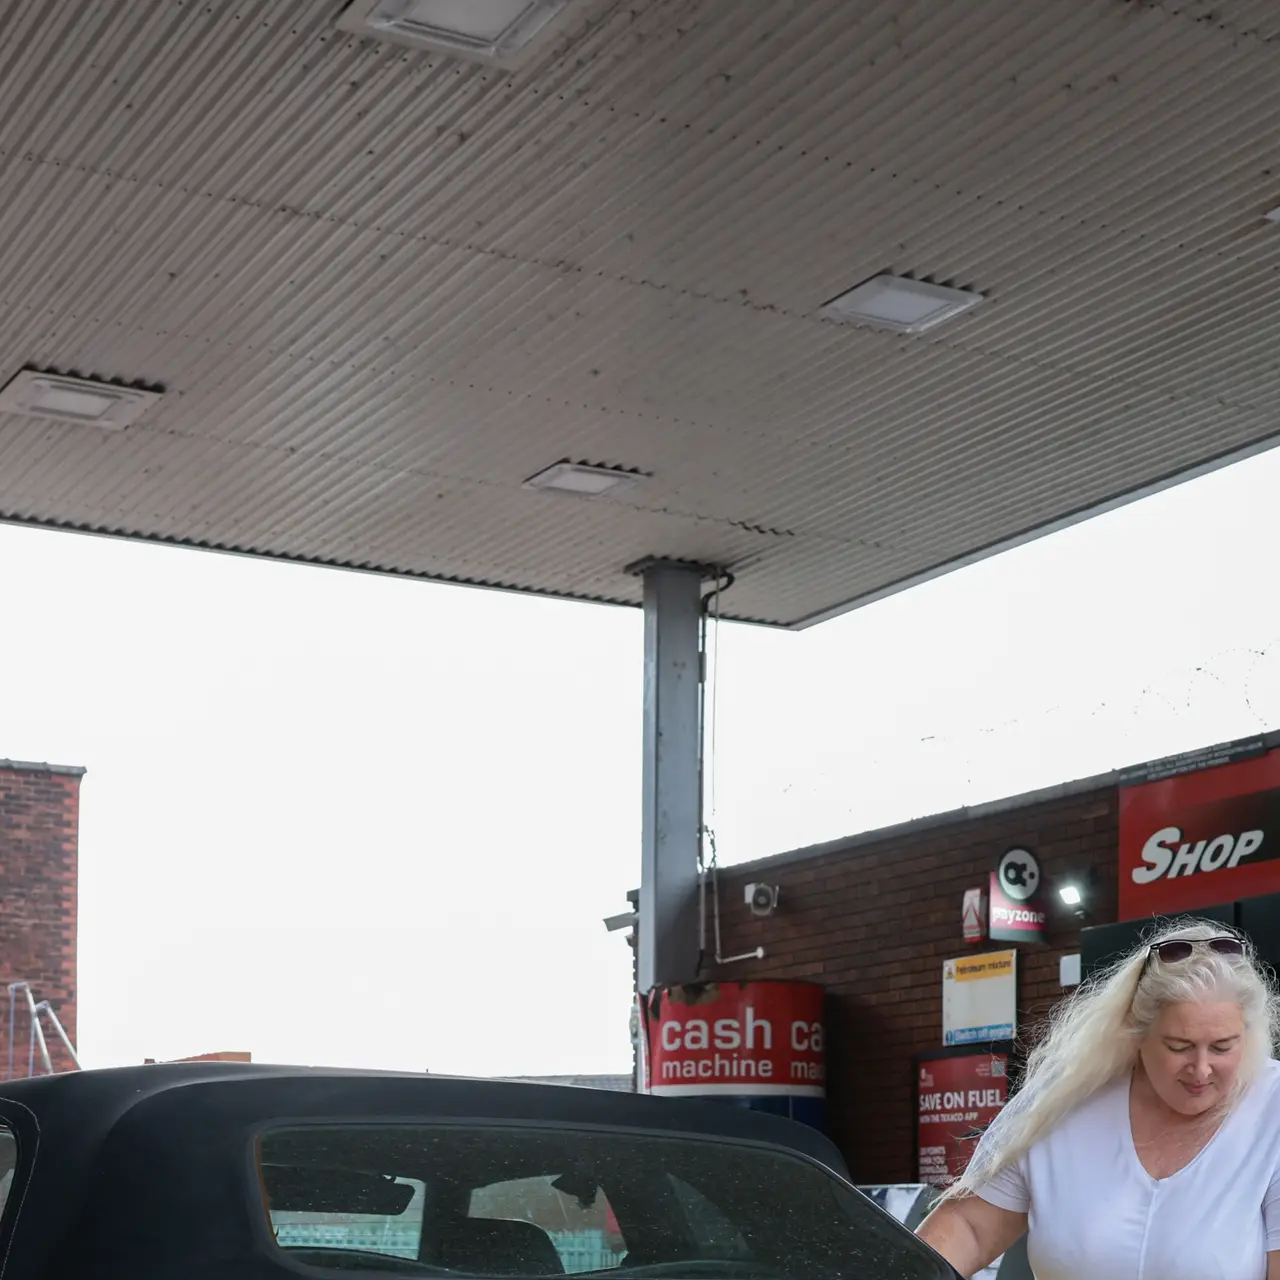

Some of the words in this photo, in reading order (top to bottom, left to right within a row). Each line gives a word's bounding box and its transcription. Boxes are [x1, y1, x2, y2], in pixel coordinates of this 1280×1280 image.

[1131, 826, 1265, 885] SHOP
[992, 906, 1045, 925] payzone
[662, 1006, 772, 1051] cash
[662, 1054, 773, 1079] machine
[920, 1092, 941, 1111] SAVE
[943, 1091, 965, 1110] ON
[967, 1088, 1005, 1108] FUEL
